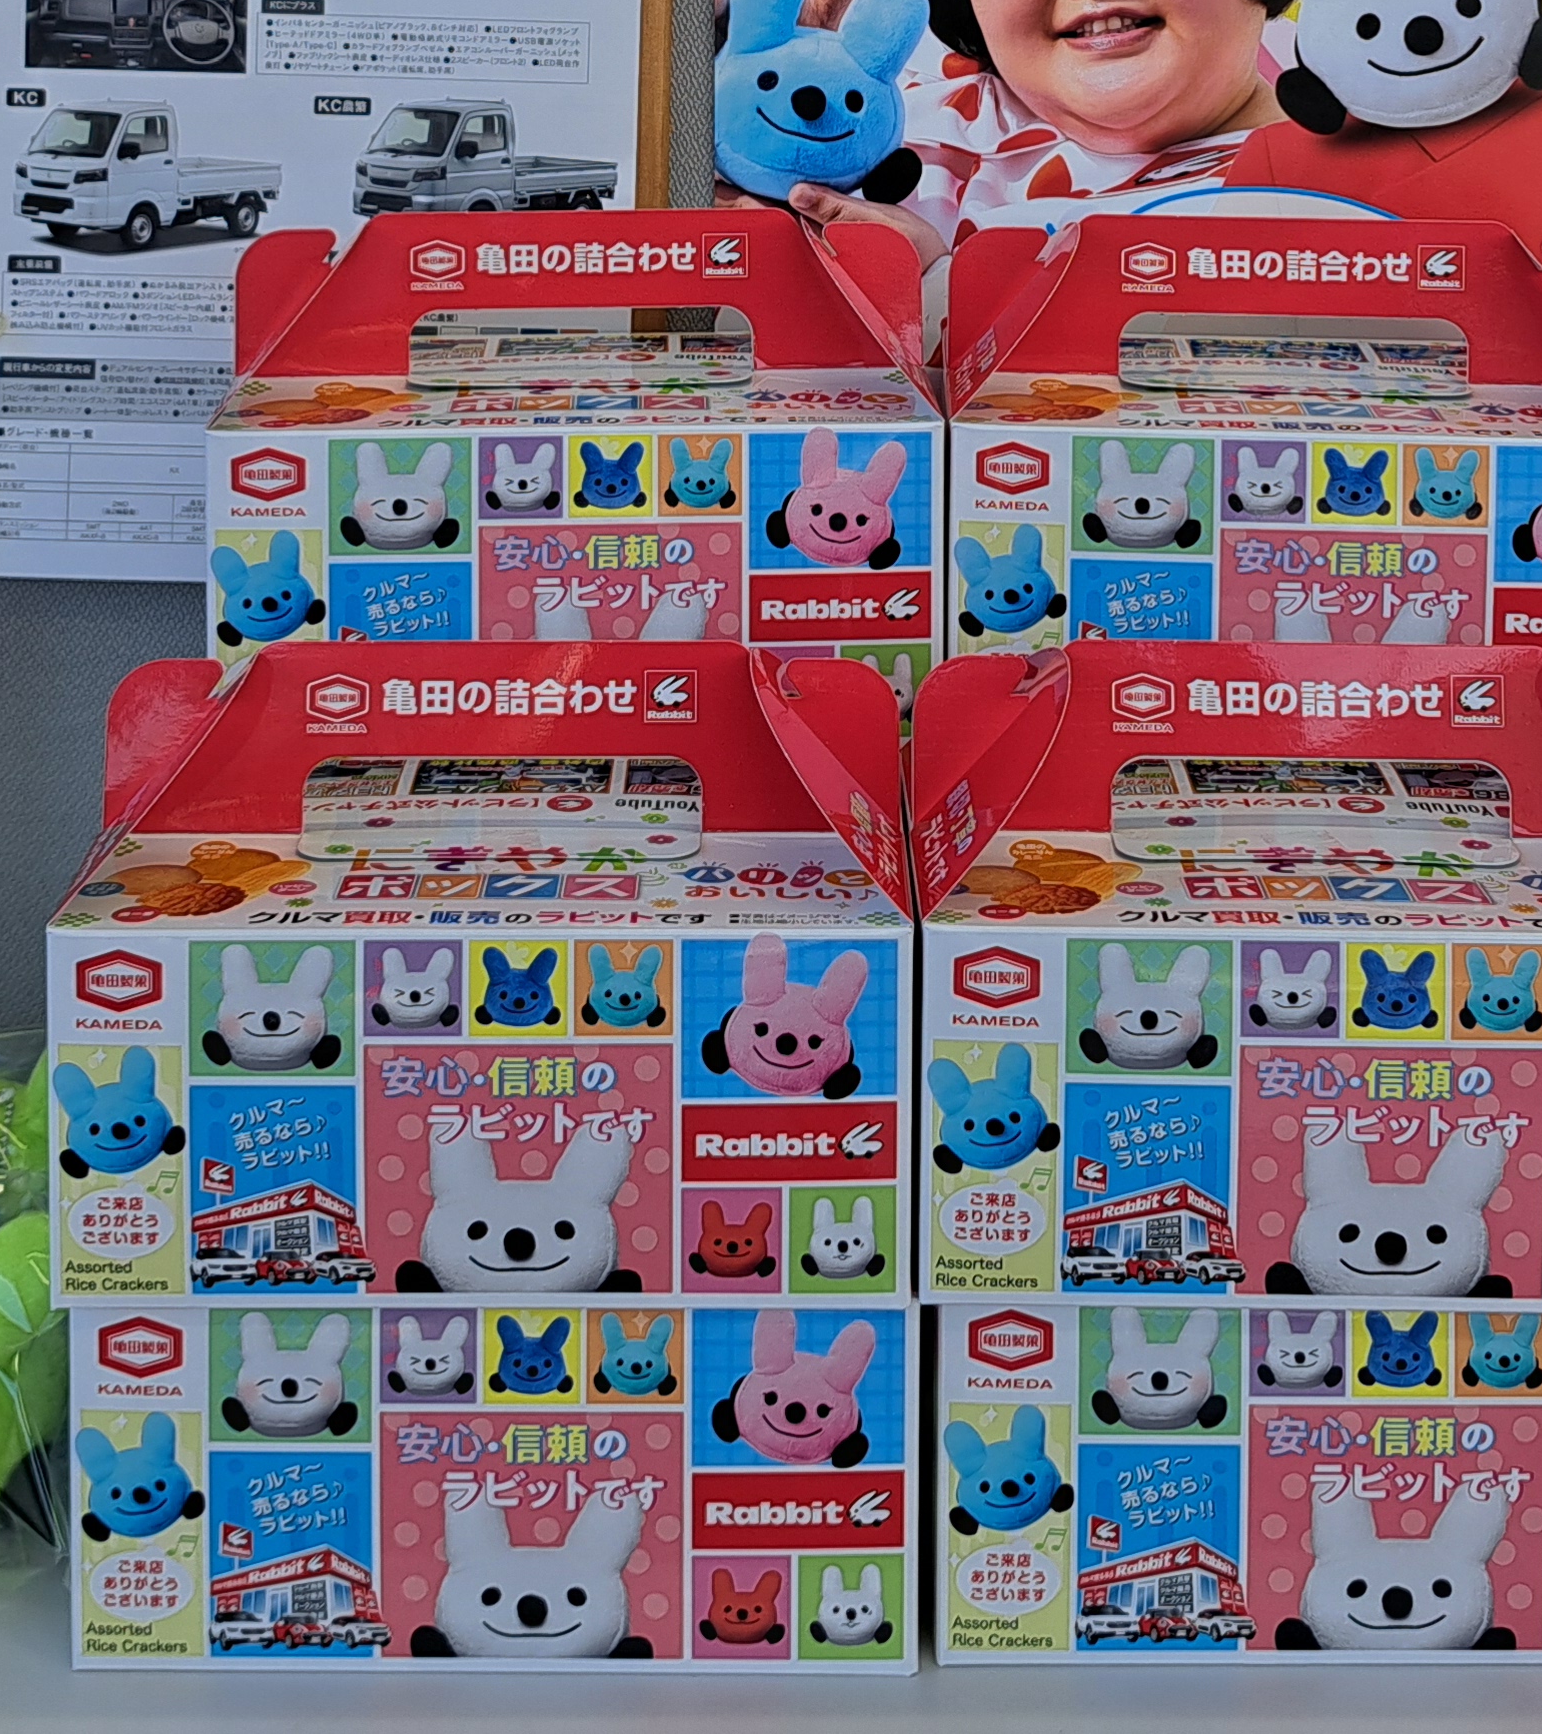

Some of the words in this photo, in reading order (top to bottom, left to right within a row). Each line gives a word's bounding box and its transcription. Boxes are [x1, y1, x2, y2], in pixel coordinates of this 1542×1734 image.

[12, 90, 39, 107] KC
[477, 244, 695, 274] 亀田の詰合わせ
[1187, 247, 1412, 282] 亀田の詰合わせ
[230, 507, 307, 518] KAMEDA
[760, 598, 878, 621] Rabbit
[382, 678, 637, 715] 亀田の詰合わせ
[338, 875, 641, 899] ボックス
[76, 1019, 162, 1031] KAMEDA
[952, 1014, 1040, 1028] KAMEDA
[1258, 1059, 1491, 1098] 安心・信頼の
[425, 1105, 653, 1144] ラビットです
[695, 1133, 835, 1159] Rabbit
[97, 1194, 144, 1211] ご来店
[83, 1213, 159, 1230] ありがとう
[83, 1230, 160, 1246] ございます
[64, 1260, 133, 1274] Assorted
[66, 1277, 96, 1291] Rice
[102, 1277, 168, 1291] Crackers
[1308, 1464, 1532, 1504] ラビットです
[705, 1500, 843, 1526] Rabbit
[122, 1639, 187, 1654] Crackers
